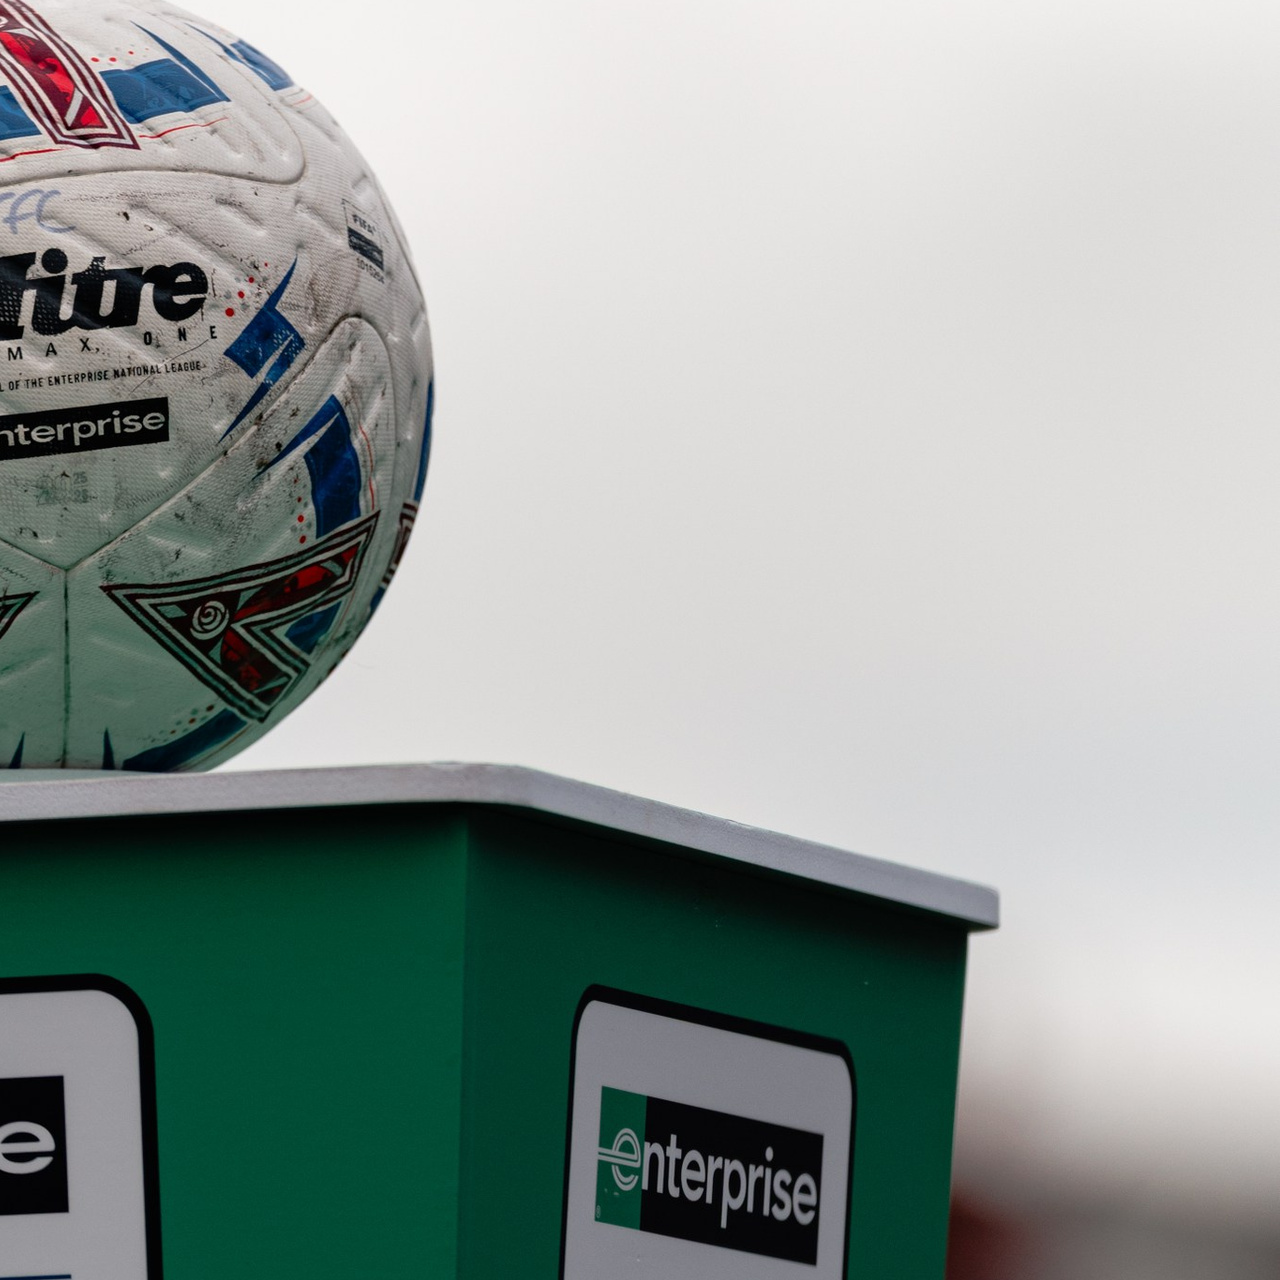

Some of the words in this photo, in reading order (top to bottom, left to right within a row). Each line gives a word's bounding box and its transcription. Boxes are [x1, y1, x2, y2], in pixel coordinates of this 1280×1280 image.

[143, 325, 218, 347] ONE
[8, 380, 21, 391] OF
[24, 377, 44, 389] THE
[47, 372, 109, 387] ENTERPRISE
[113, 364, 162, 379] NATIONAL
[164, 360, 202, 374] LEAGUE
[603, 1126, 818, 1229] enterprise
